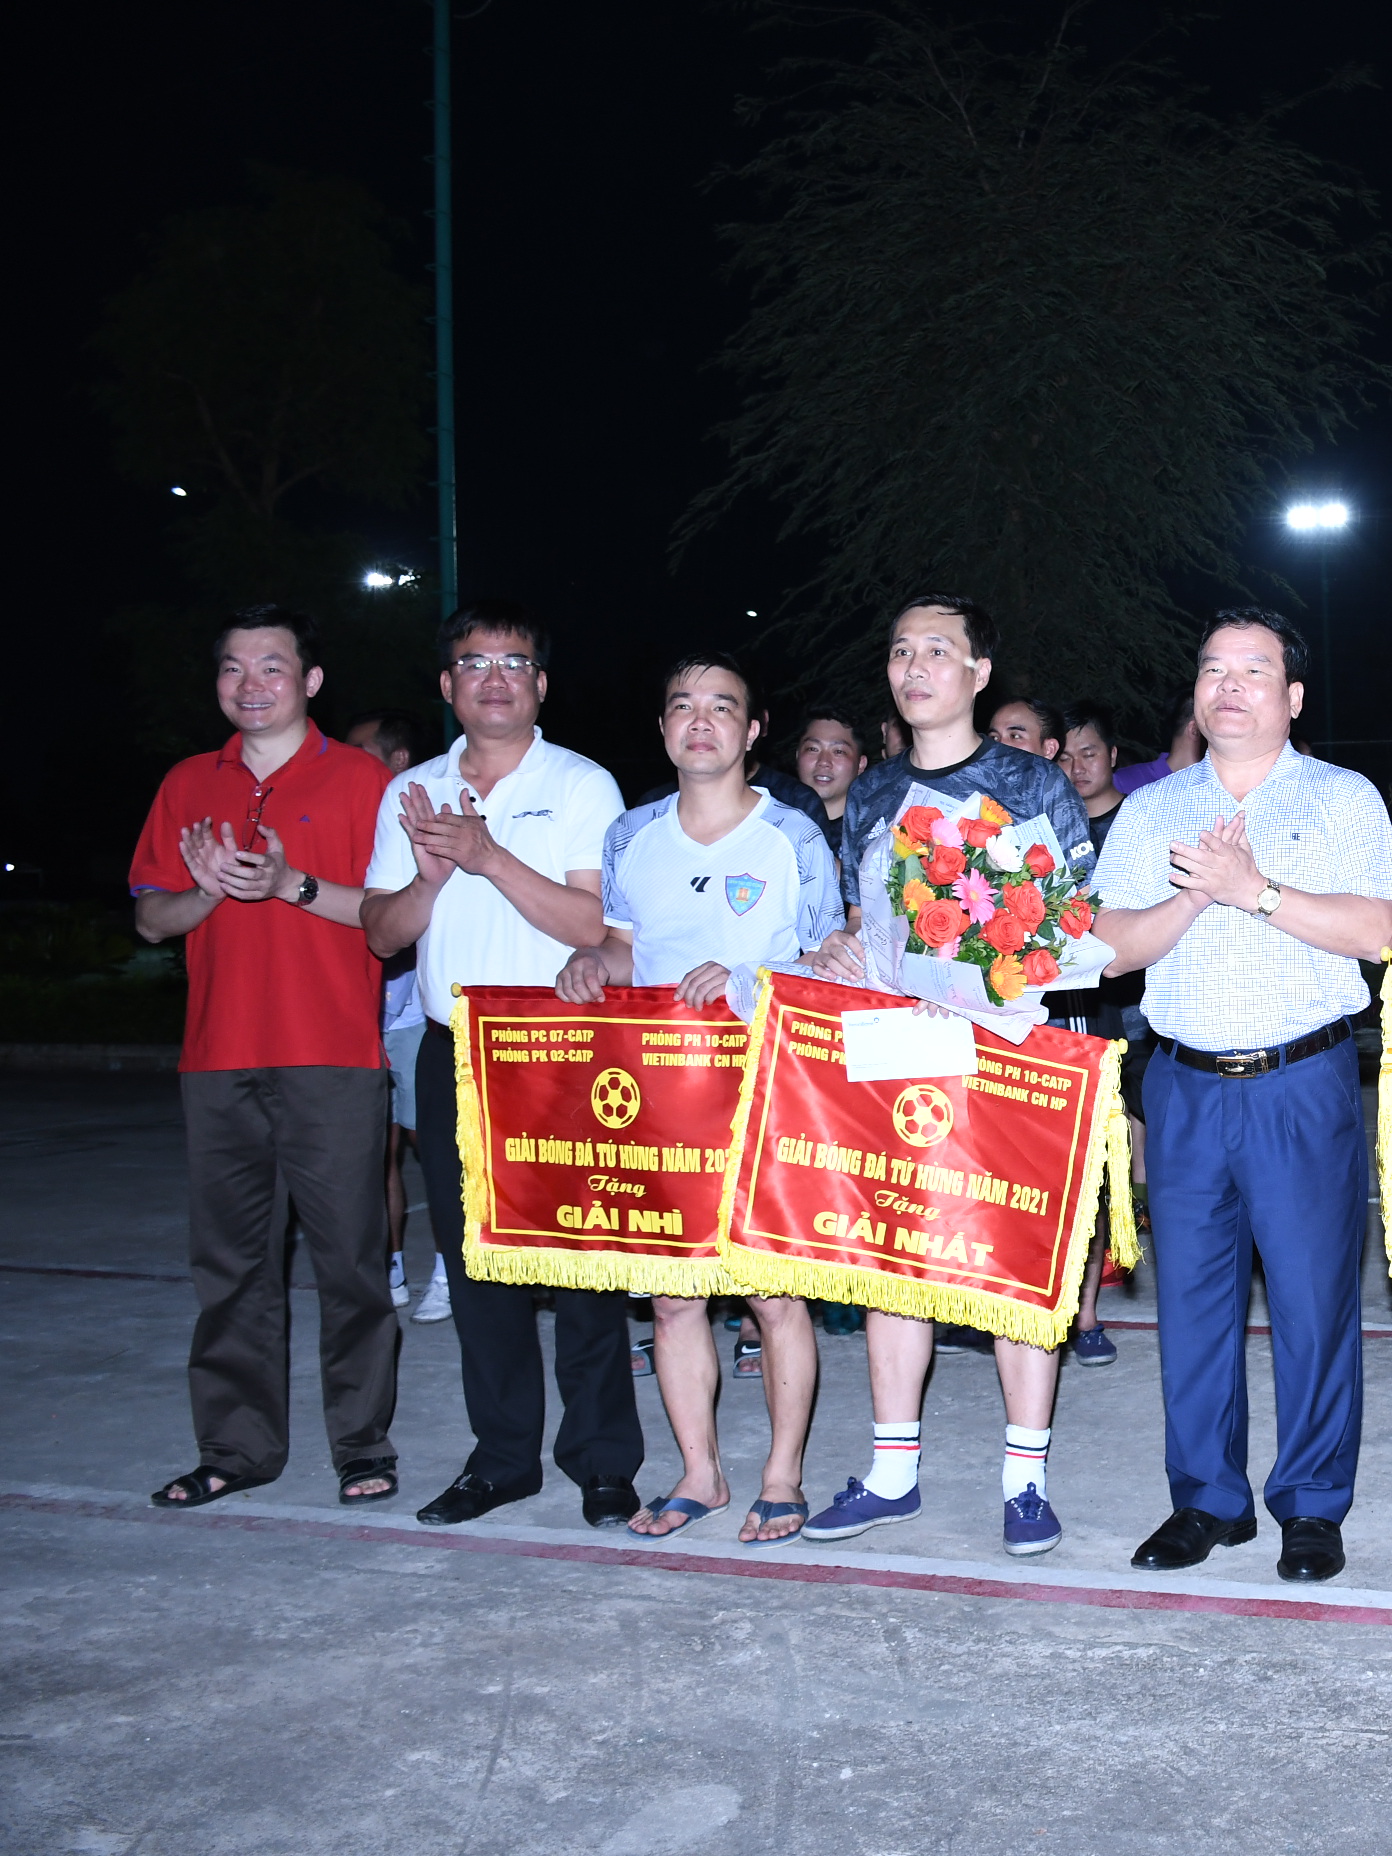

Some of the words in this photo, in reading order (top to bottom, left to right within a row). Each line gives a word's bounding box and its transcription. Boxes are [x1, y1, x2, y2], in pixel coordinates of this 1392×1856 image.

[491, 1027, 528, 1042] PHÒNG
[531, 1030, 547, 1042] PC
[549, 1030, 594, 1042] 07-CATP
[642, 1030, 681, 1046] PHÒNG
[684, 1034, 701, 1046] PH
[705, 1034, 748, 1047] 10-CATP
[791, 1019, 832, 1043] PHÒNG
[834, 1032, 844, 1043] P
[492, 1047, 529, 1062] PHÒNG
[531, 1050, 549, 1062] PK
[551, 1050, 594, 1062] 02-CATP
[642, 1053, 711, 1067] VIETINBANK
[714, 1054, 730, 1067] CN
[732, 1054, 746, 1068] HP
[788, 1040, 829, 1063] PHÒNG
[976, 1056, 1003, 1077] ÒNG
[1004, 1064, 1021, 1080] PH
[1023, 1070, 1072, 1092] 10-CATP
[961, 1074, 1029, 1103] VIETINBANK
[1031, 1090, 1049, 1108] CN
[1050, 1095, 1068, 1112] HP
[505, 1132, 535, 1162] GIẢI
[538, 1135, 573, 1165] BÓNG
[575, 1138, 594, 1167] ĐÁ
[596, 1139, 618, 1168] TỨ
[619, 1141, 659, 1171] HÙNG
[662, 1143, 701, 1172] NĂM
[705, 1148, 730, 1173] 20
[588, 1174, 647, 1198] Tặng
[777, 1132, 814, 1166] GIẢI
[813, 1141, 862, 1176] BÓNG
[863, 1151, 888, 1181] ĐÁ
[890, 1156, 916, 1187] TỨ
[915, 1161, 965, 1197] HÙNG
[967, 1170, 1010, 1206] NĂM
[1010, 1183, 1050, 1217] 2021
[556, 1200, 620, 1230] GIẢI
[874, 1189, 942, 1221] Tặng
[812, 1211, 888, 1246] GIẢI
